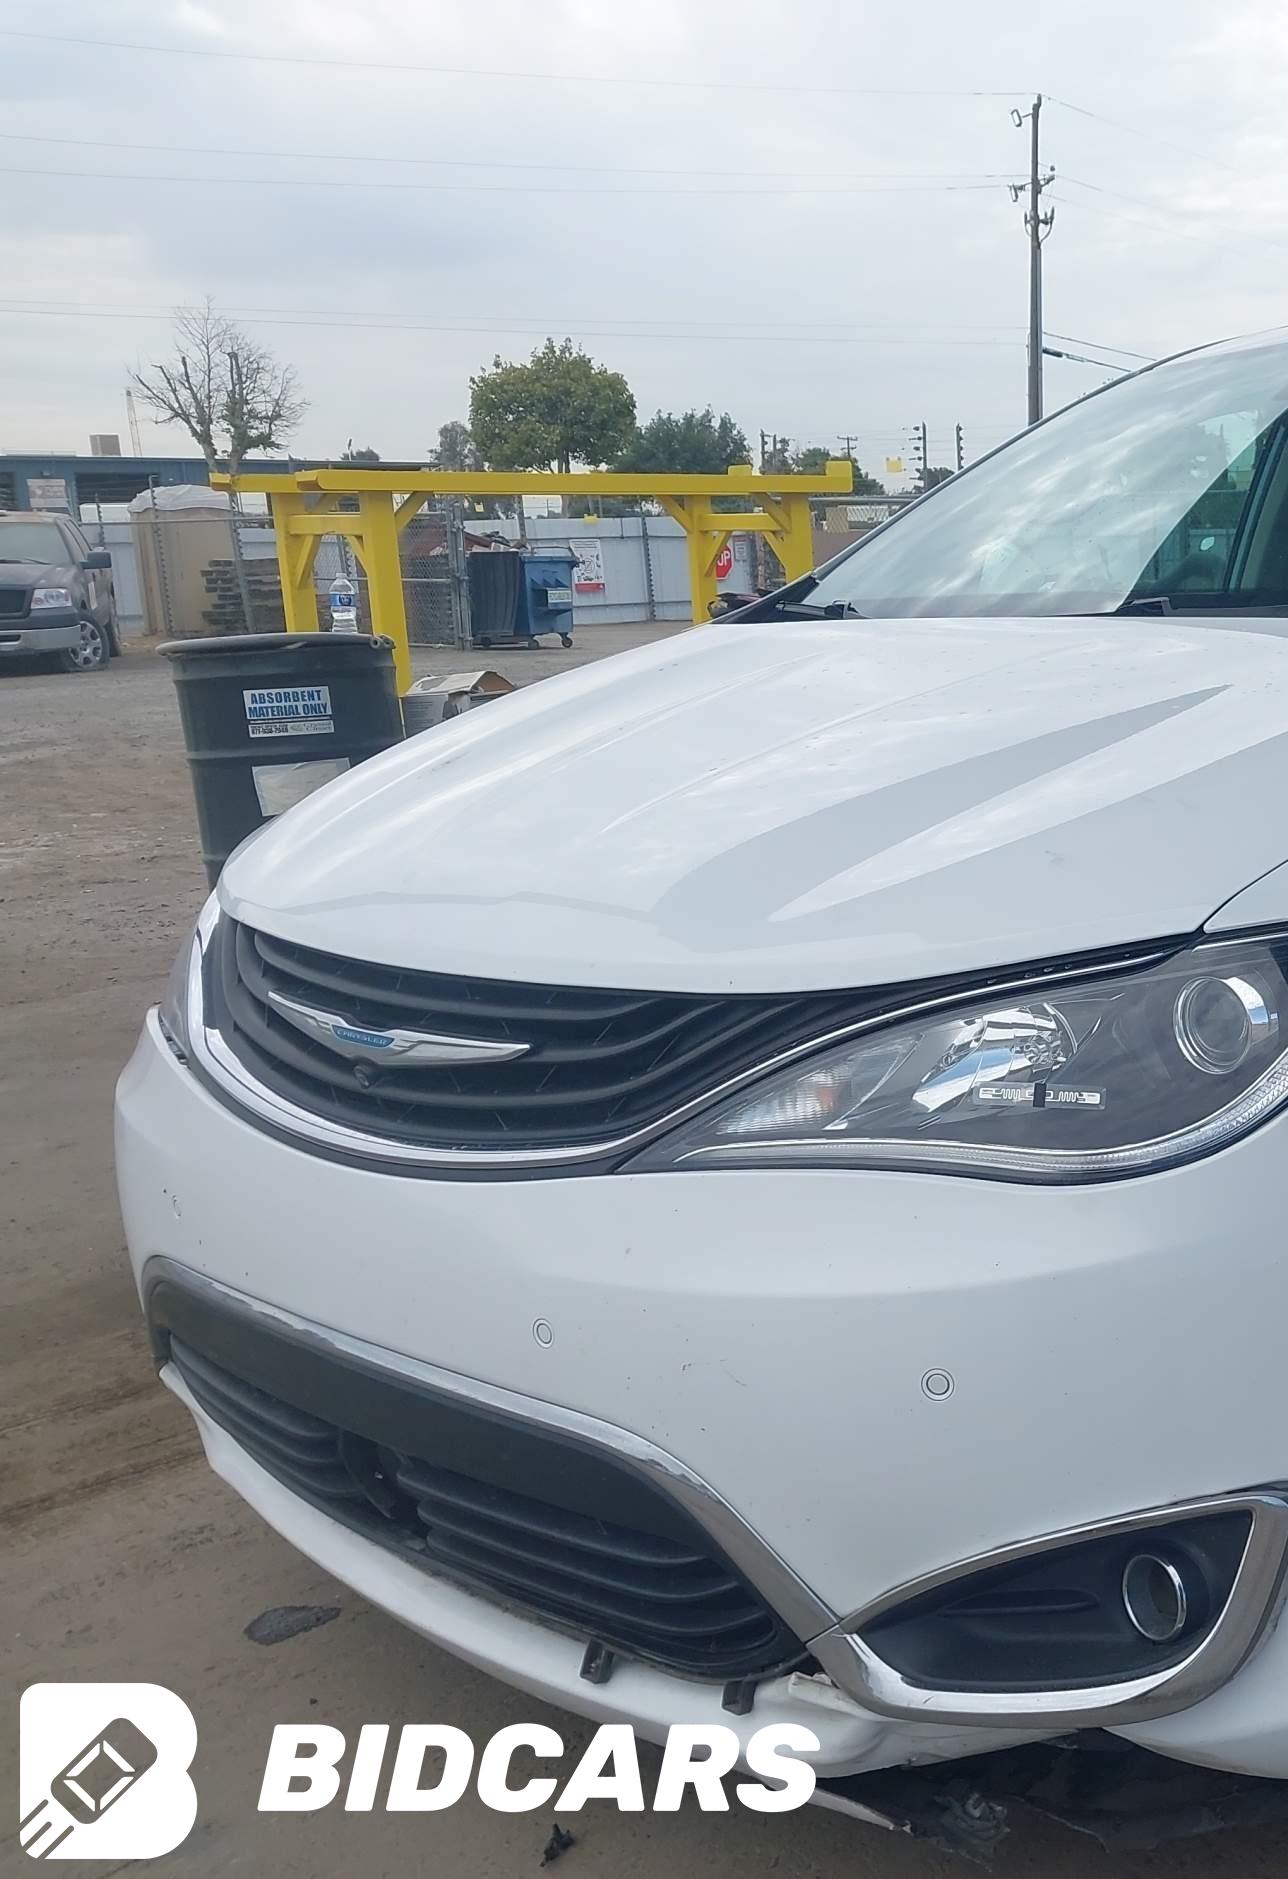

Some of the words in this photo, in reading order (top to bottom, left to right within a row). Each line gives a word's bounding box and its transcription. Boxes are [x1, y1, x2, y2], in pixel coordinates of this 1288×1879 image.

[250, 690, 322, 705] ABSORBENT
[248, 704, 301, 718] MATERIAL
[302, 702, 328, 715] ONLY
